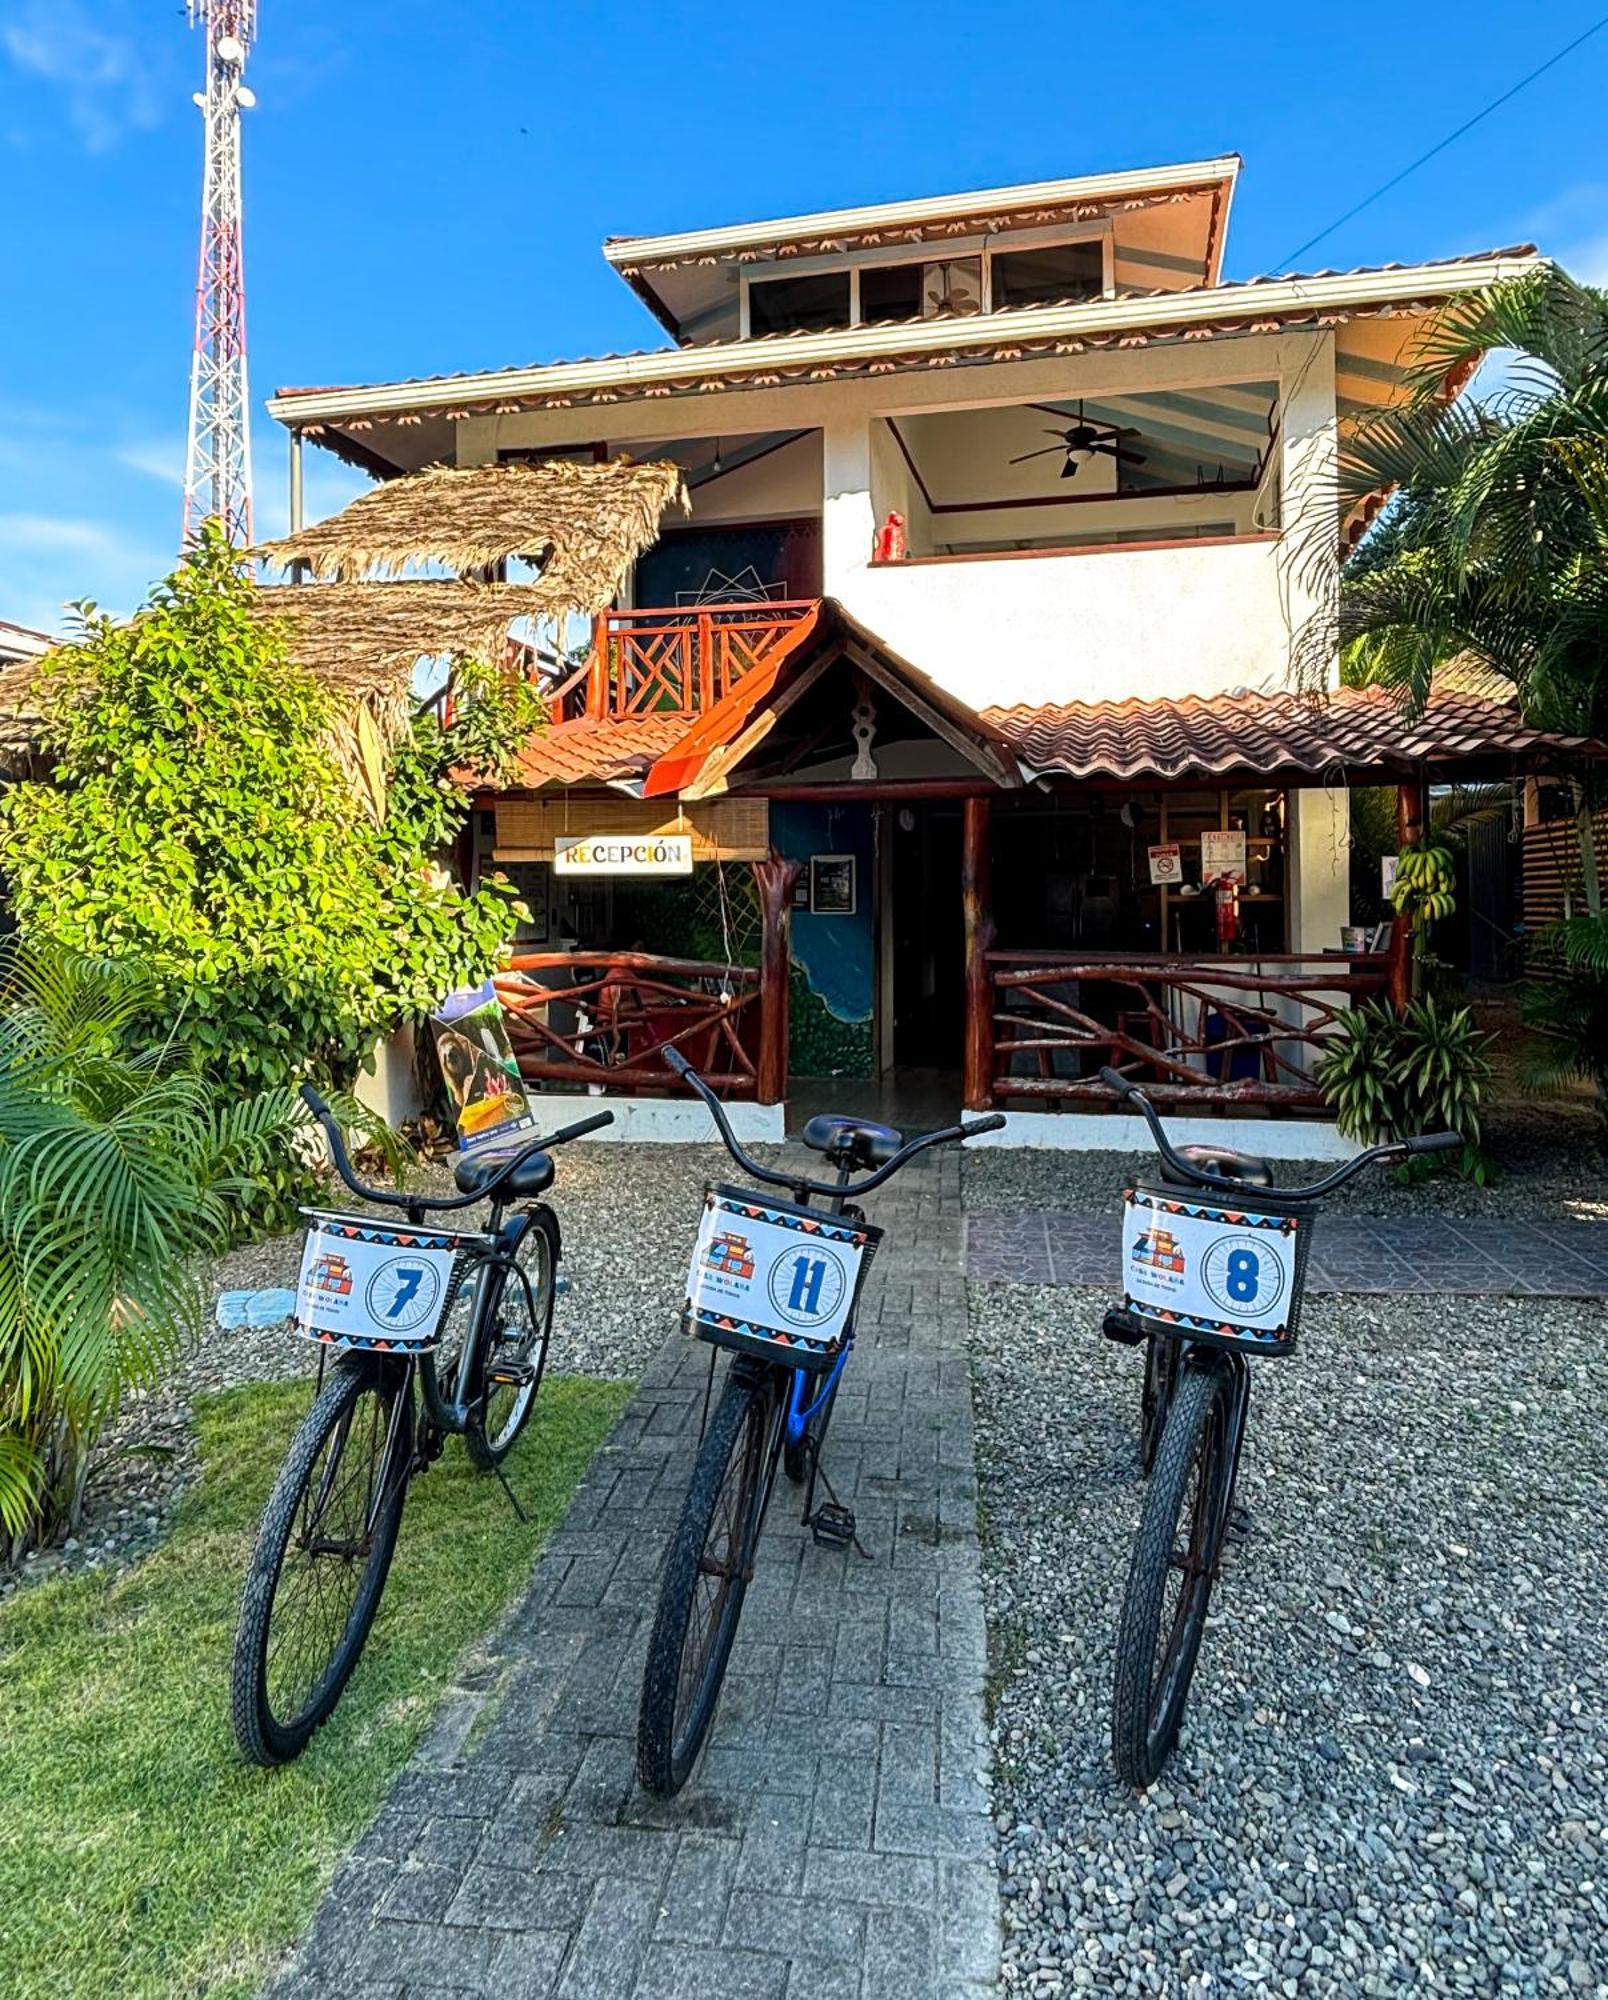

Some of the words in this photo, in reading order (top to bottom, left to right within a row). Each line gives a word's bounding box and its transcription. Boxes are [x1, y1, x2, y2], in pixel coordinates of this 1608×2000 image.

[566, 840, 681, 864] RECEPCIÓN
[385, 1268, 424, 1318] 7
[788, 1256, 827, 1316] 11
[1226, 1249, 1260, 1303] 8
